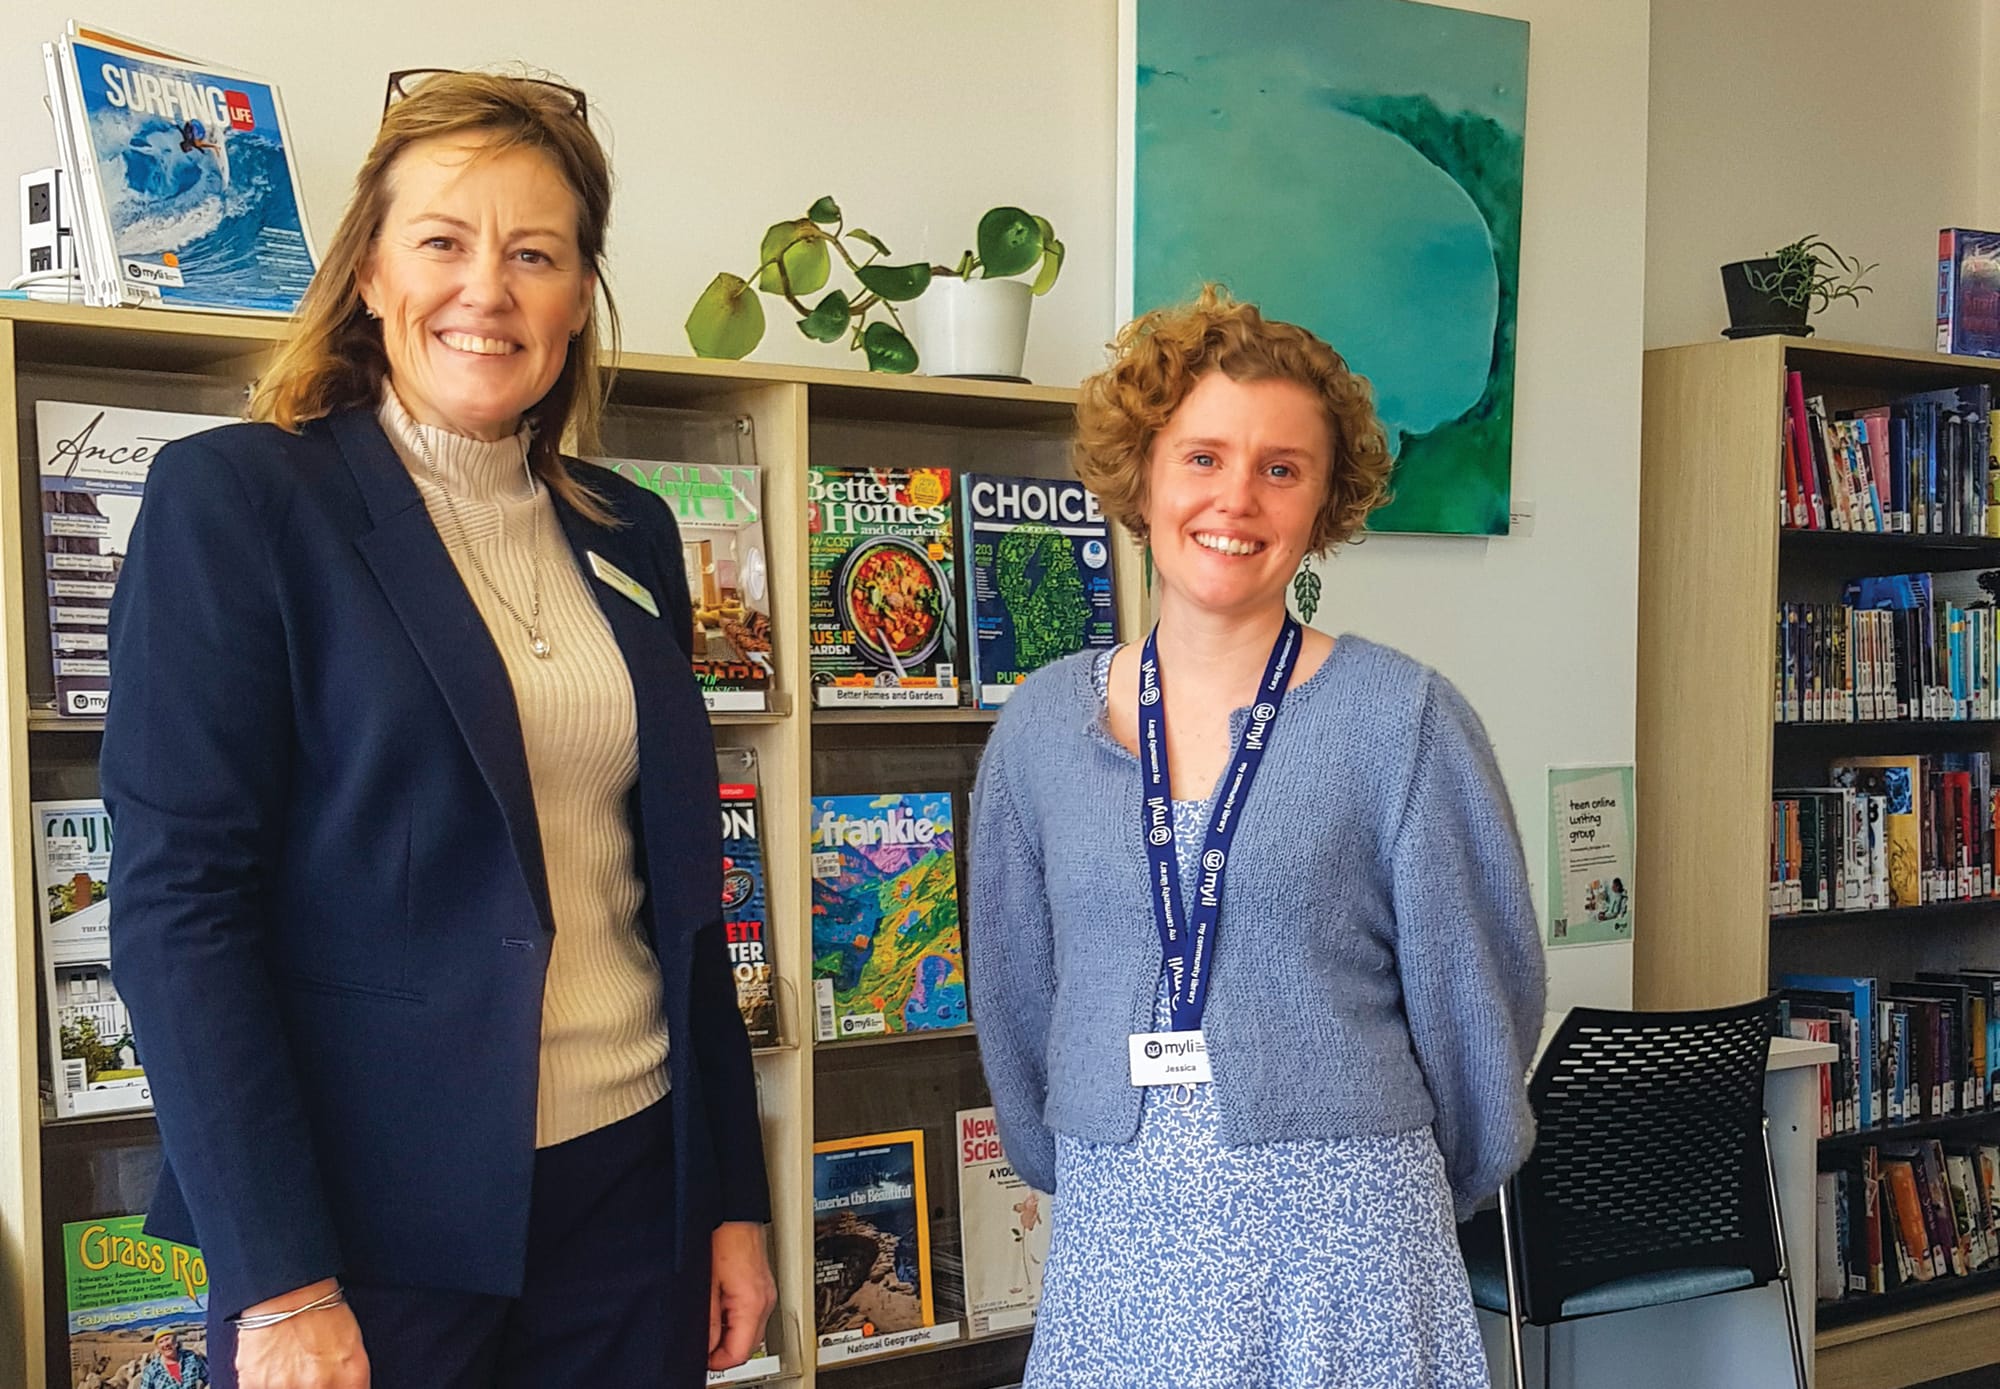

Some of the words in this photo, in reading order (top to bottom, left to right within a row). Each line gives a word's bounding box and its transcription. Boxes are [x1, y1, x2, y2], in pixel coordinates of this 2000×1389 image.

[101, 62, 231, 128] SURFING
[230, 106, 253, 124] LIFE
[48, 411, 157, 482] Ance
[808, 470, 905, 503] Better
[972, 481, 1104, 522] CHOICE
[823, 502, 945, 534] Homes
[860, 525, 885, 535] and
[888, 525, 947, 537] Gardens
[813, 630, 856, 644] USSIE
[1142, 659, 1156, 689] myli
[837, 690, 862, 699] Better
[863, 690, 889, 700] Homes
[892, 690, 908, 700] and
[909, 690, 943, 700] Gardens
[1246, 722, 1266, 750] myli
[1224, 773, 1244, 808] community
[1148, 796, 1167, 828] myli
[1570, 799, 1591, 811] teen
[1592, 798, 1616, 810] online
[819, 806, 935, 847] frankie
[1216, 808, 1231, 833] library
[1570, 812, 1601, 827] writing
[1570, 828, 1596, 844] group
[1160, 861, 1168, 886] library
[1200, 872, 1217, 906] myli
[1161, 886, 1174, 930] community
[1190, 935, 1204, 978] community
[1187, 978, 1200, 1004] library
[1164, 1039, 1194, 1056] myli
[1165, 1064, 1196, 1073] Jessica
[850, 1191, 867, 1206] the
[867, 1184, 912, 1203] Beautiful
[80, 1225, 165, 1274] Grass
[847, 1338, 882, 1354] National
[884, 1330, 931, 1347] Geographic
